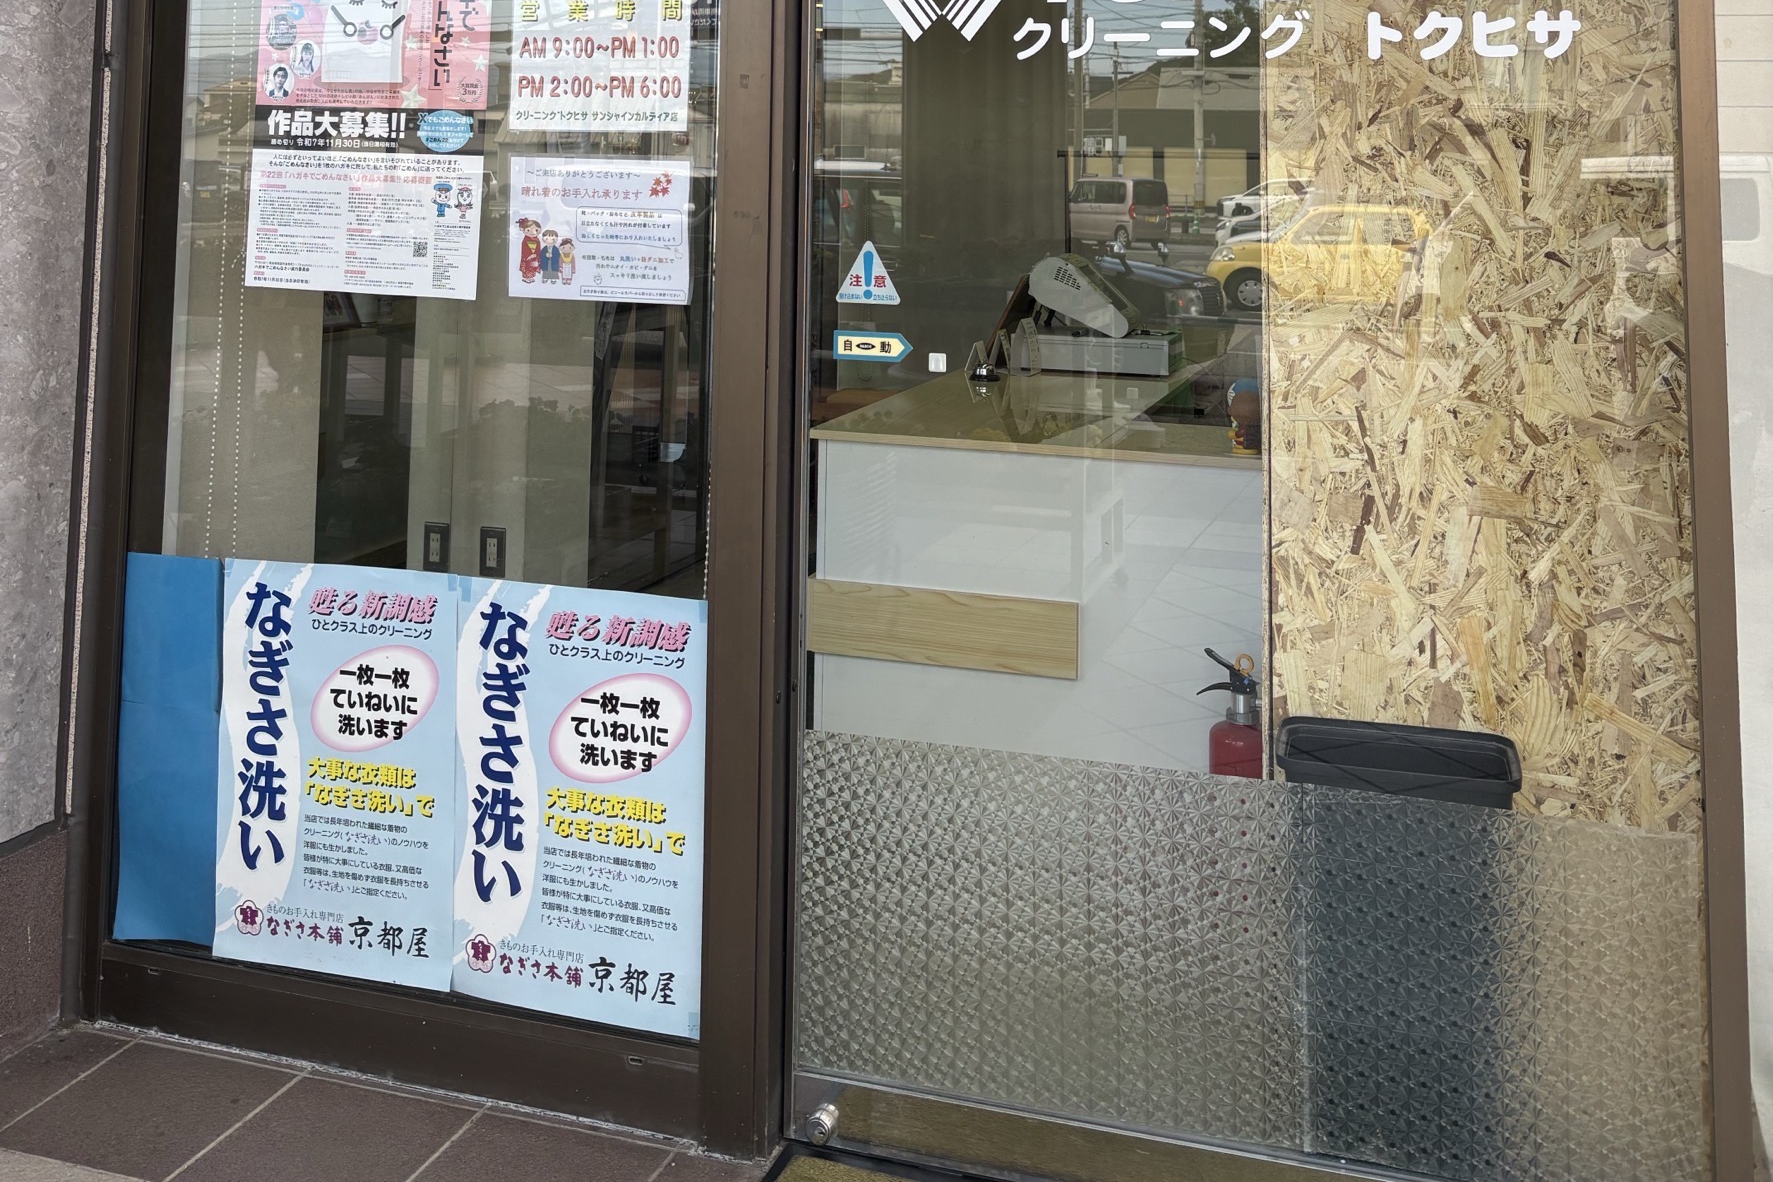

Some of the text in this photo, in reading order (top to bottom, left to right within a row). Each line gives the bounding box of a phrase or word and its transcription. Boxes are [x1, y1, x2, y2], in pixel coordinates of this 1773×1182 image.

[519, 0, 684, 22] 営業時間
[518, 36, 547, 58] AM
[641, 35, 680, 58] 1:00
[1013, 9, 1582, 60] クリーニング トクヒサ
[517, 75, 544, 98] PM
[640, 75, 682, 98] 6:00
[267, 109, 406, 139] 作品大募集!!
[516, 110, 588, 121] クリーニングトクヒサ
[521, 186, 643, 201] 晴れ着のお手入れ承ります
[849, 274, 887, 288] 注意
[311, 619, 432, 640] ひとクラス上のクリーニング
[549, 644, 685, 669] ひとクラス上のクリーニング
[339, 663, 410, 689] 一枚一枚
[330, 687, 418, 715] ていねいに
[580, 692, 660, 720] 一枚一枚
[237, 581, 295, 871] なぎさ洗い
[338, 713, 407, 741] 洗います
[570, 714, 669, 747] ていねいに
[472, 602, 530, 903] なぎさ洗い
[579, 742, 657, 772] 洗います
[307, 756, 416, 789] 大事な衣類は
[545, 786, 667, 824] 大事な衣類は
[303, 840, 368, 856] 洋服にも生かしました。
[542, 873, 613, 893] 洋服にも生かしました。
[266, 903, 344, 924] きものお手入れ専門店
[348, 916, 430, 958] 京都屋
[500, 939, 584, 964] きものお手入れ専門店
[588, 957, 676, 1006] 京都屋
